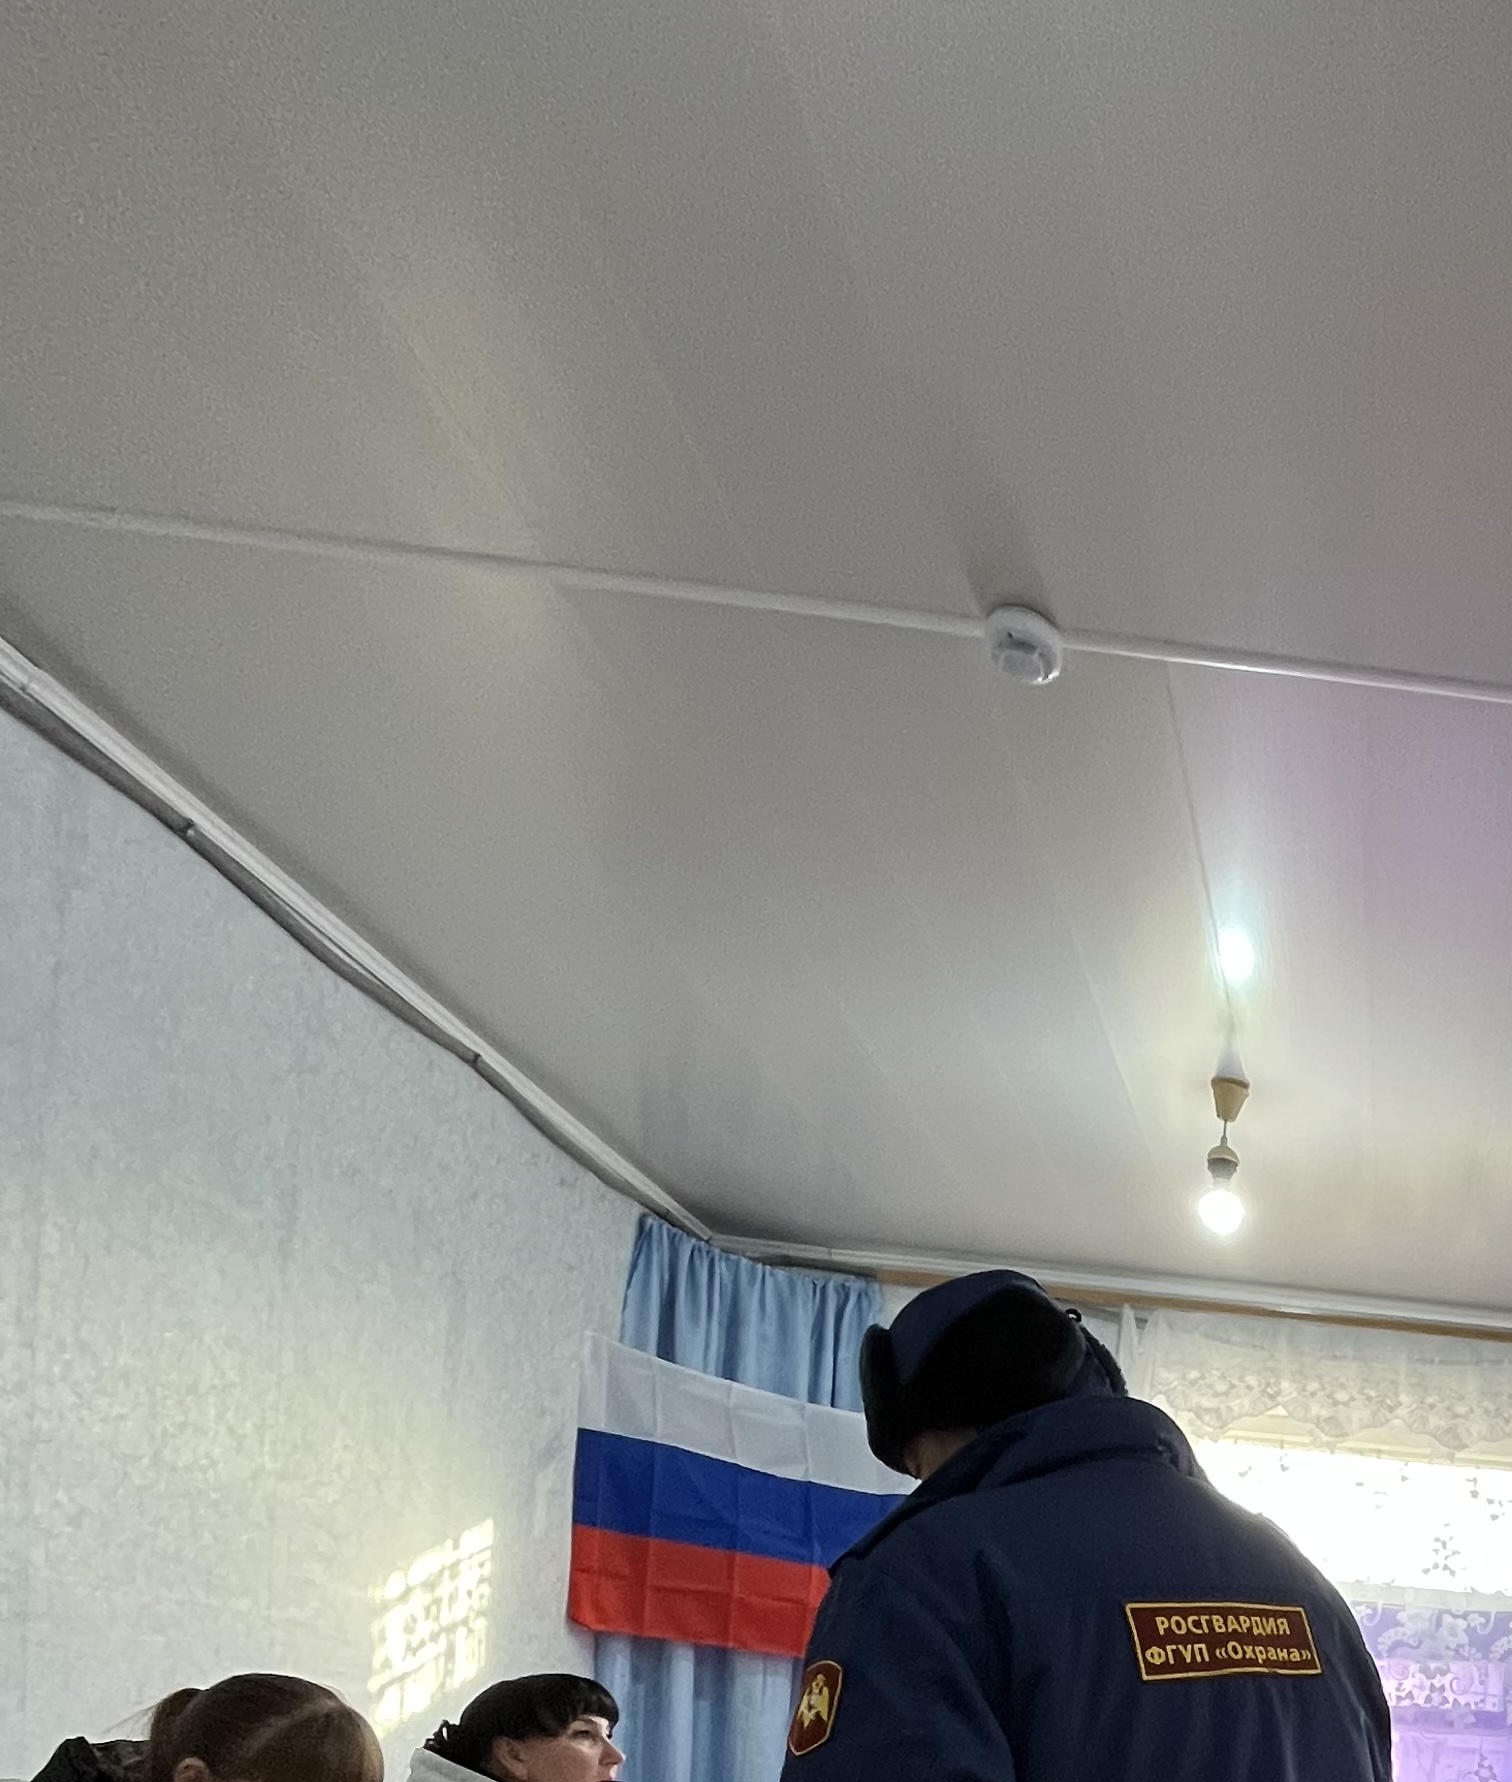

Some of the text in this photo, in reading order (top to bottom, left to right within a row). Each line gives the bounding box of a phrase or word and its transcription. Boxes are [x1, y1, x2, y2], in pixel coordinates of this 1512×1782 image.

[1155, 1615, 1291, 1636] РОСГВАРДИЯ
[1145, 1641, 1312, 1666] ФГУП «Охрана»
